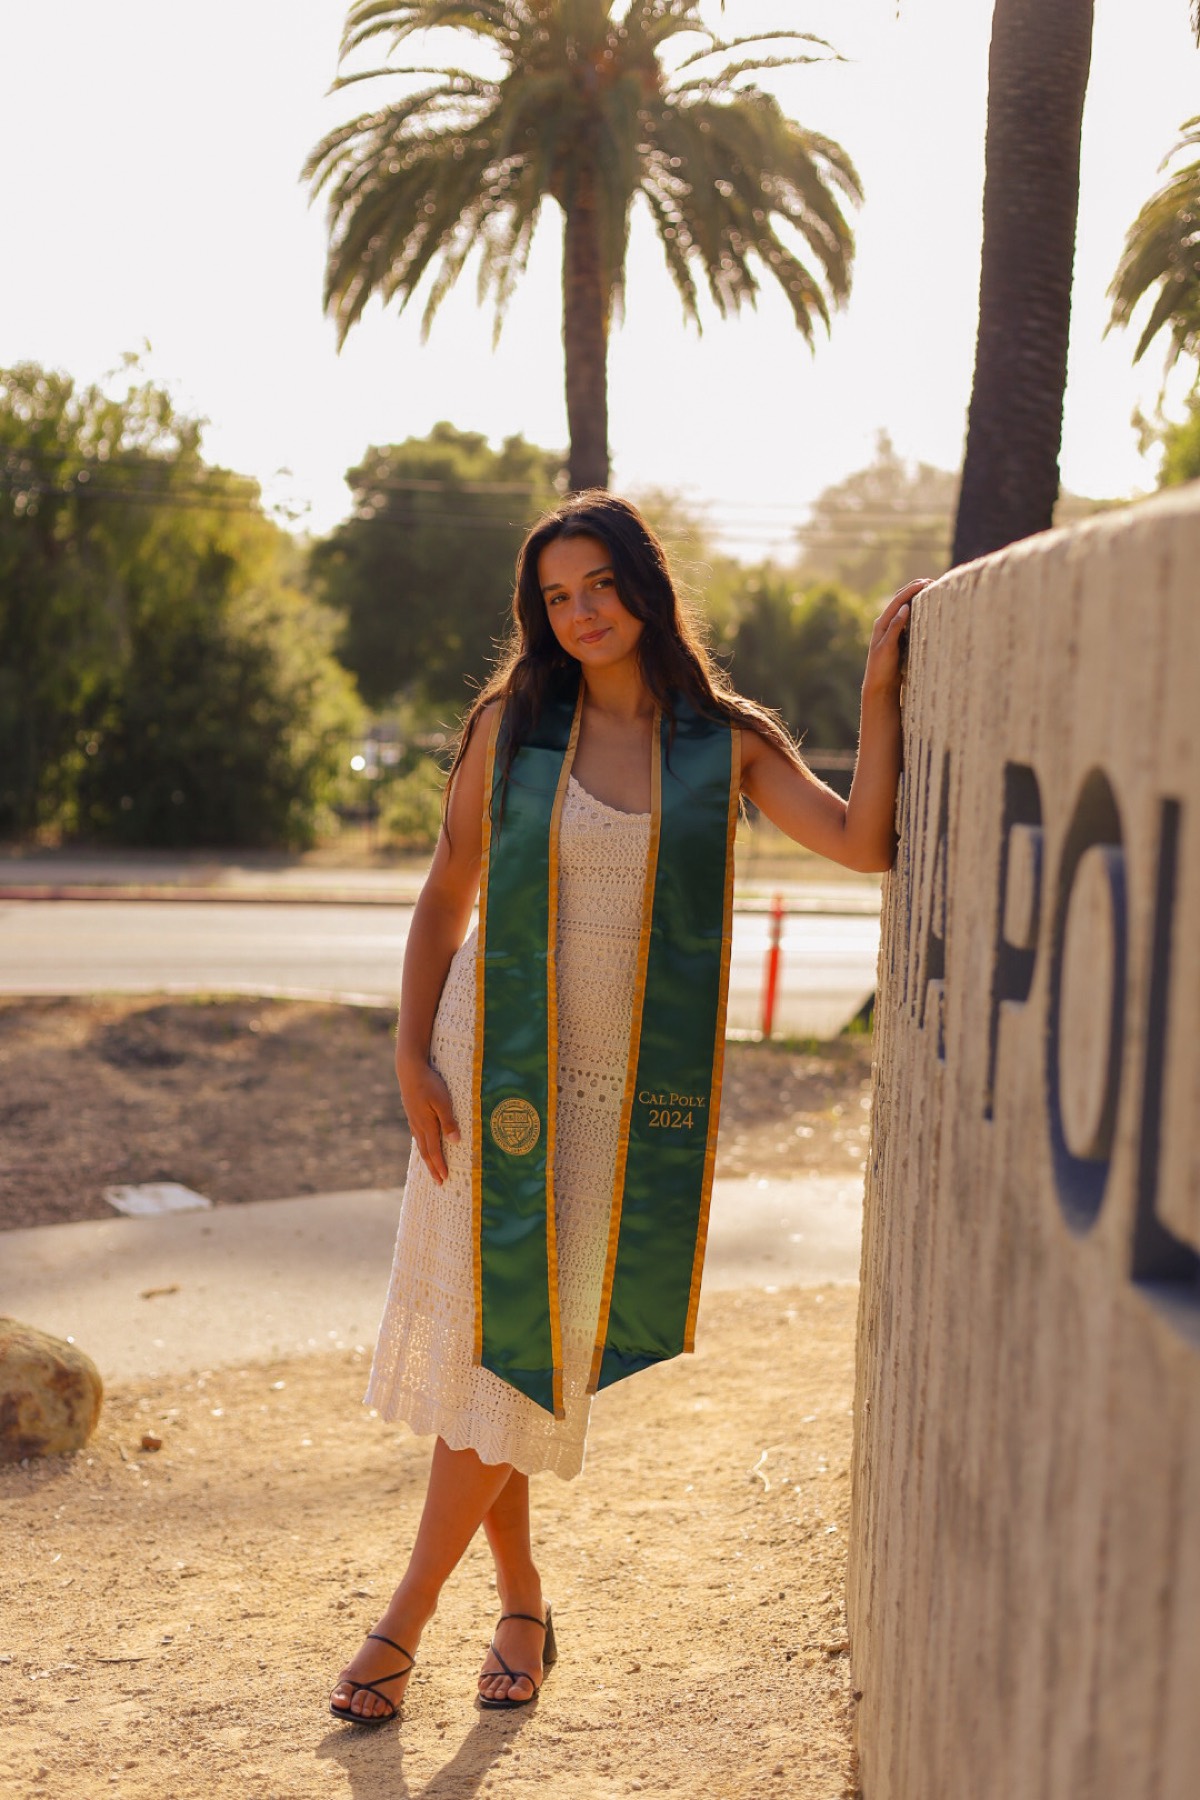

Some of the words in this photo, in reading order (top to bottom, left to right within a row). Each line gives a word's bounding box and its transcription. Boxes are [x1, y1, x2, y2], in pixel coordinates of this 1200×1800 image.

[639, 1091, 667, 1106] CAL
[669, 1093, 705, 1107] POLY
[648, 1109, 694, 1129] 2024
